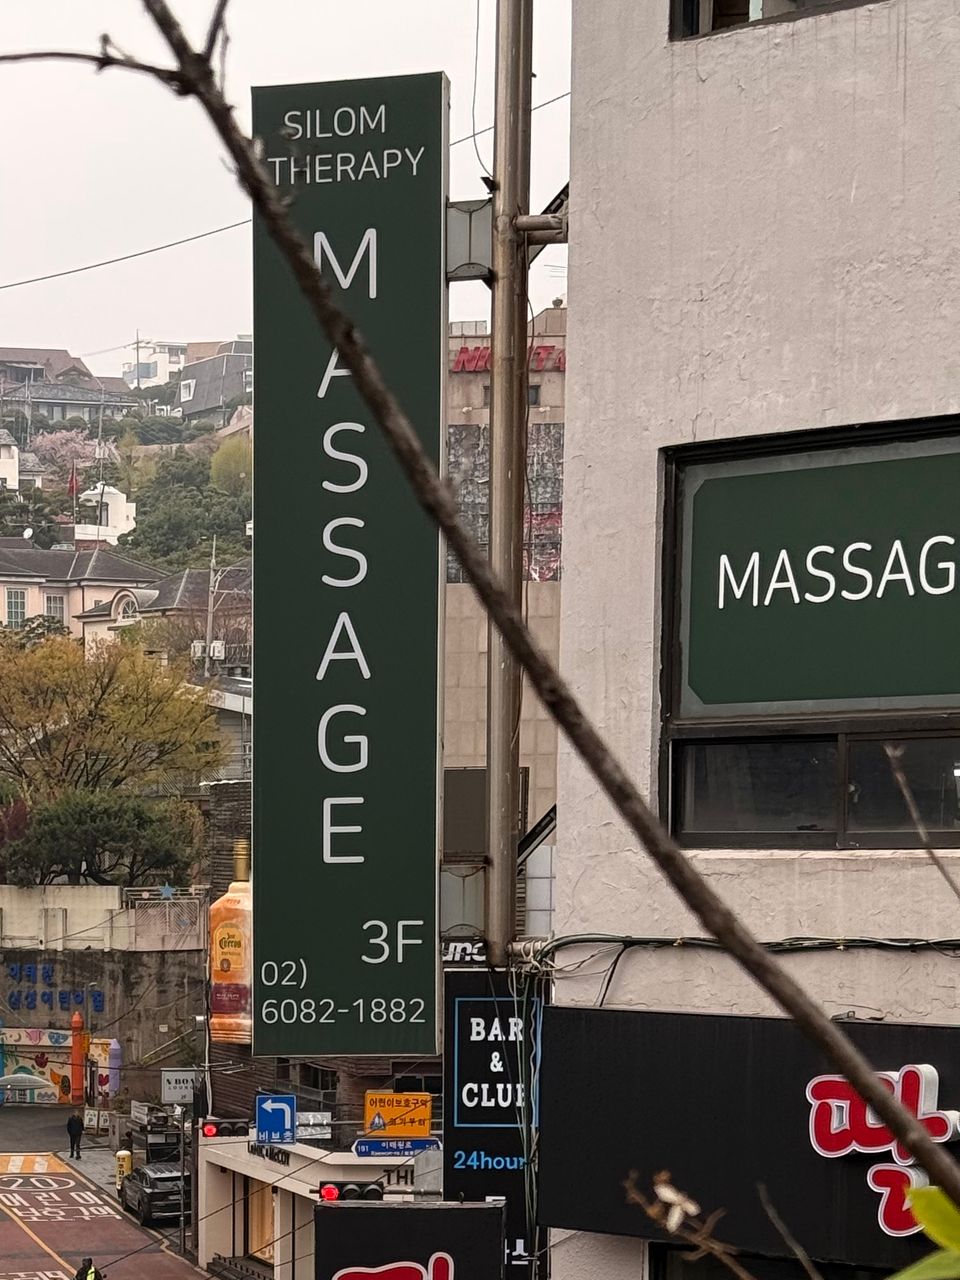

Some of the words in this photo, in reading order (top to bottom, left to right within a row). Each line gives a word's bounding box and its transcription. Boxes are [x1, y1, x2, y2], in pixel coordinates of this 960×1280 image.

[282, 104, 387, 140] SILOM
[267, 146, 425, 186] THERAPY
[360, 919, 425, 965] 3F
[260, 959, 308, 990] 02)
[260, 997, 426, 1025] 6082-1882
[469, 1017, 524, 1041] BAR
[489, 1051, 503, 1073] &
[0, 1176, 60, 1190] 20
